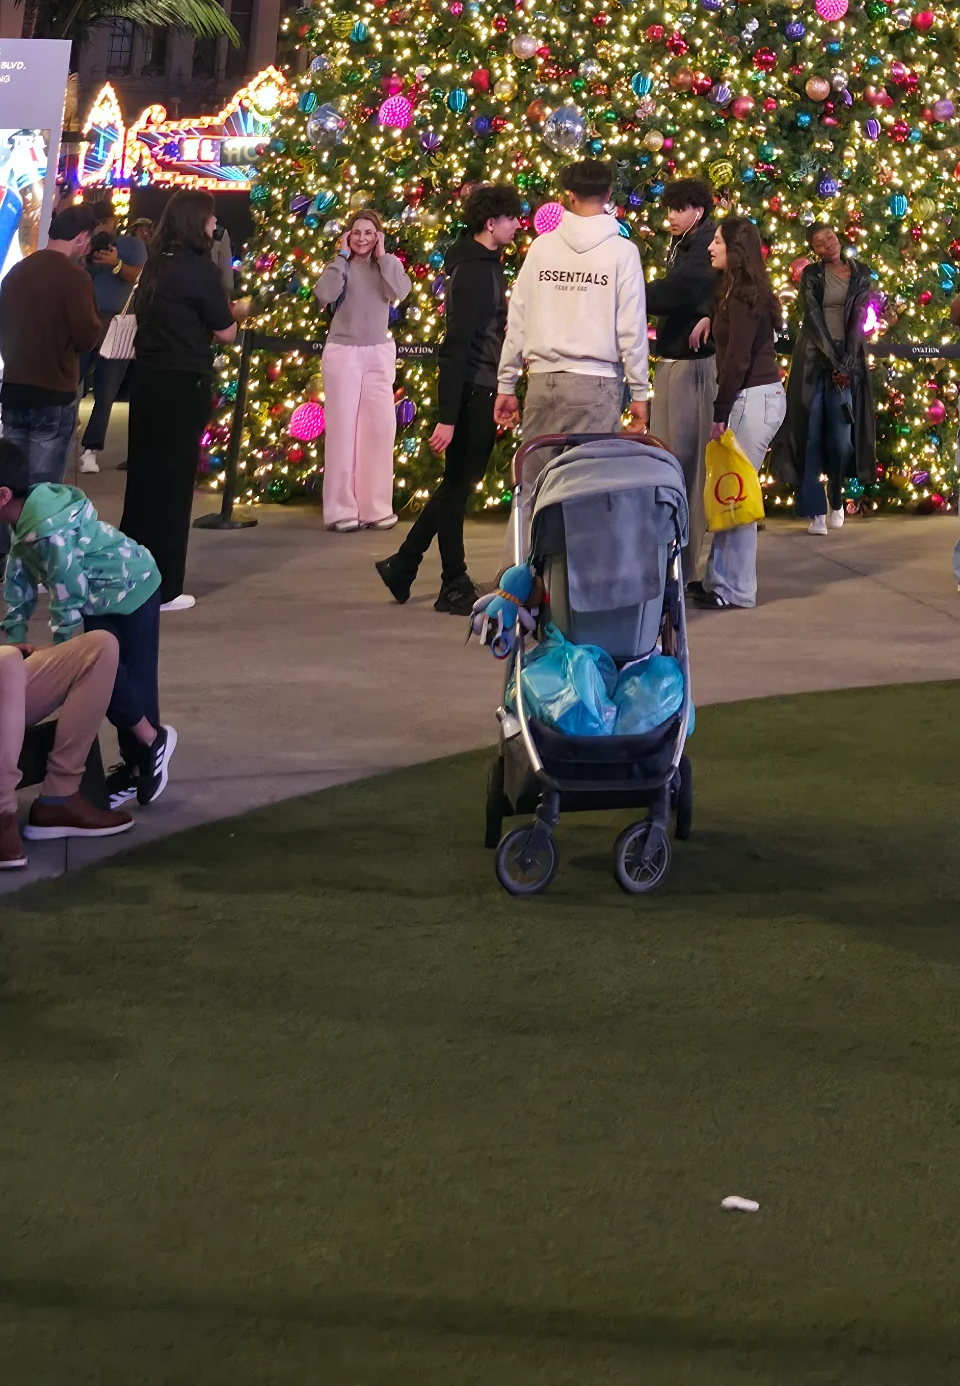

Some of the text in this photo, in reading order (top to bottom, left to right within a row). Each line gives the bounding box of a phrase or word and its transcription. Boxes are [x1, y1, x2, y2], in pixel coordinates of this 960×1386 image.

[539, 270, 609, 286] ESSENTIALS
[398, 345, 434, 354] OVATION
[912, 345, 940, 354] OVATION
[715, 472, 748, 506] Q
